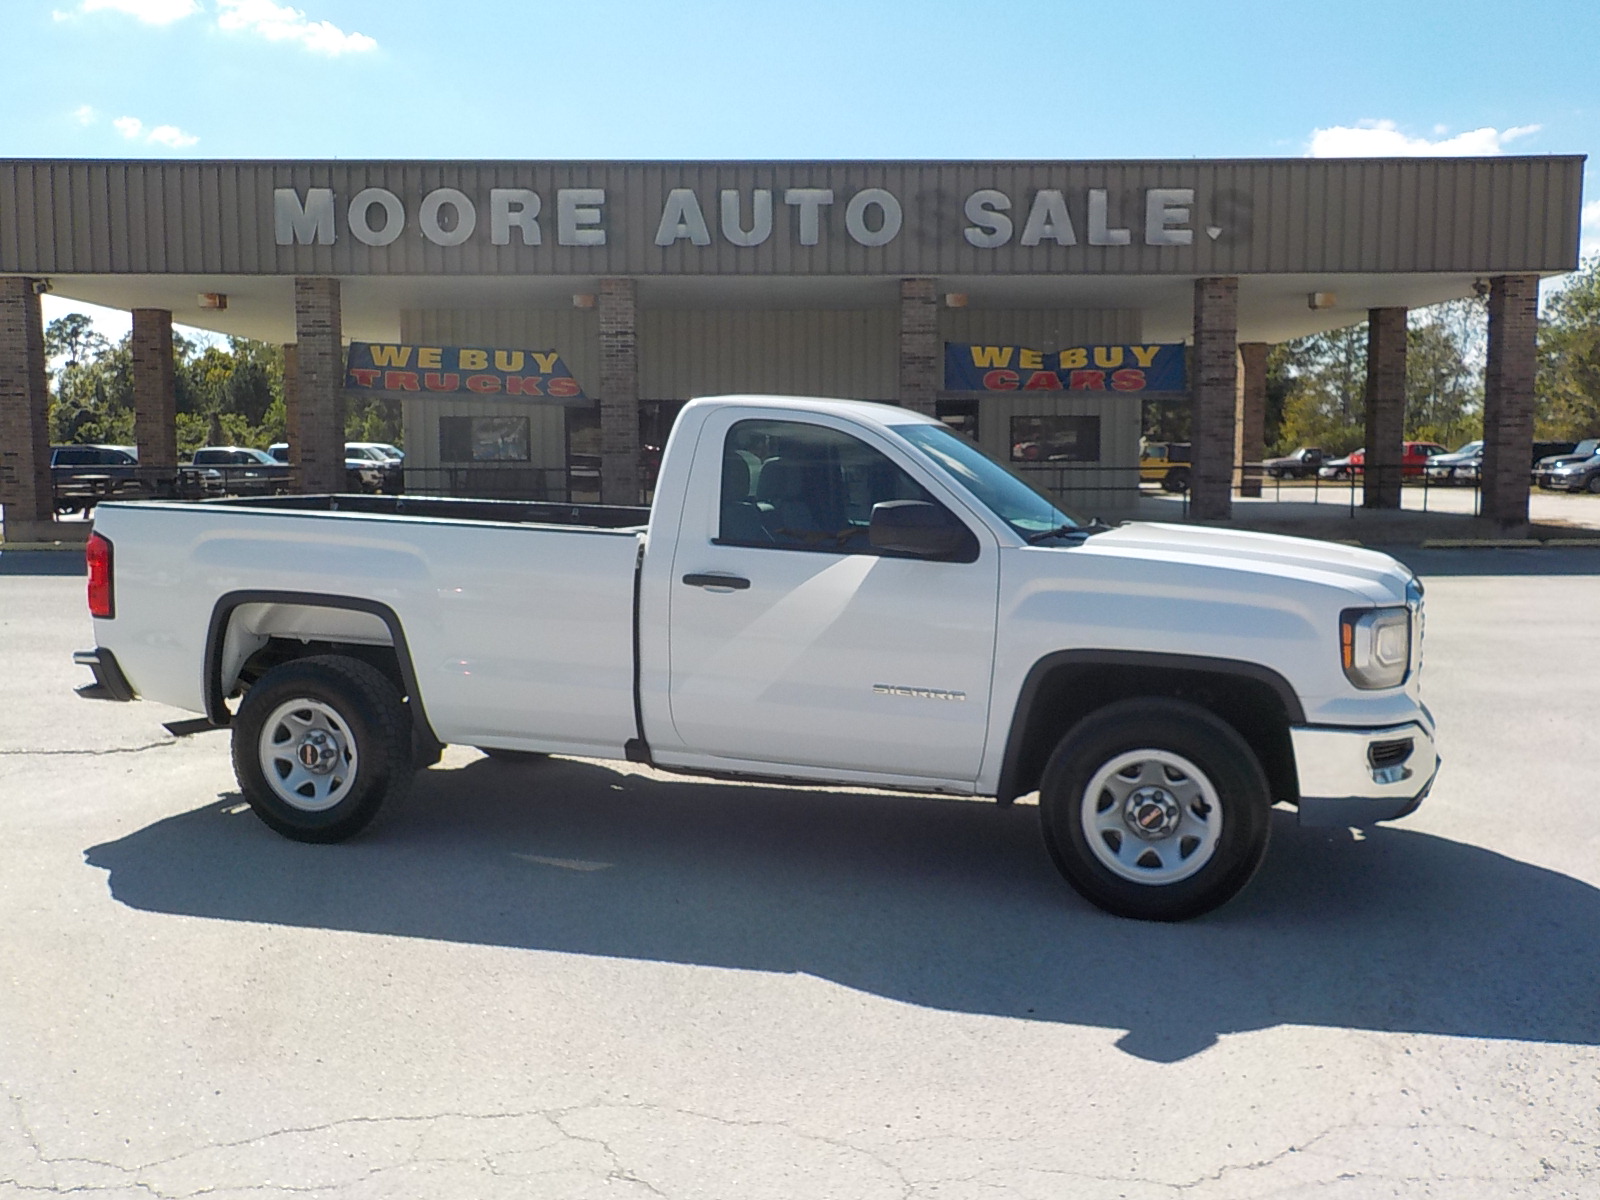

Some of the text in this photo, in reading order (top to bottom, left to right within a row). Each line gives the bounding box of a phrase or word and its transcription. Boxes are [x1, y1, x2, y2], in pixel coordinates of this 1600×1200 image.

[273, 187, 1251, 249] MOORE AUTO SALE
[369, 345, 559, 374] WE BUY
[969, 345, 1162, 370] WE BUY
[349, 368, 581, 397] TRUCKS
[982, 369, 1147, 392] CARS
[872, 683, 967, 702] SIERRA
